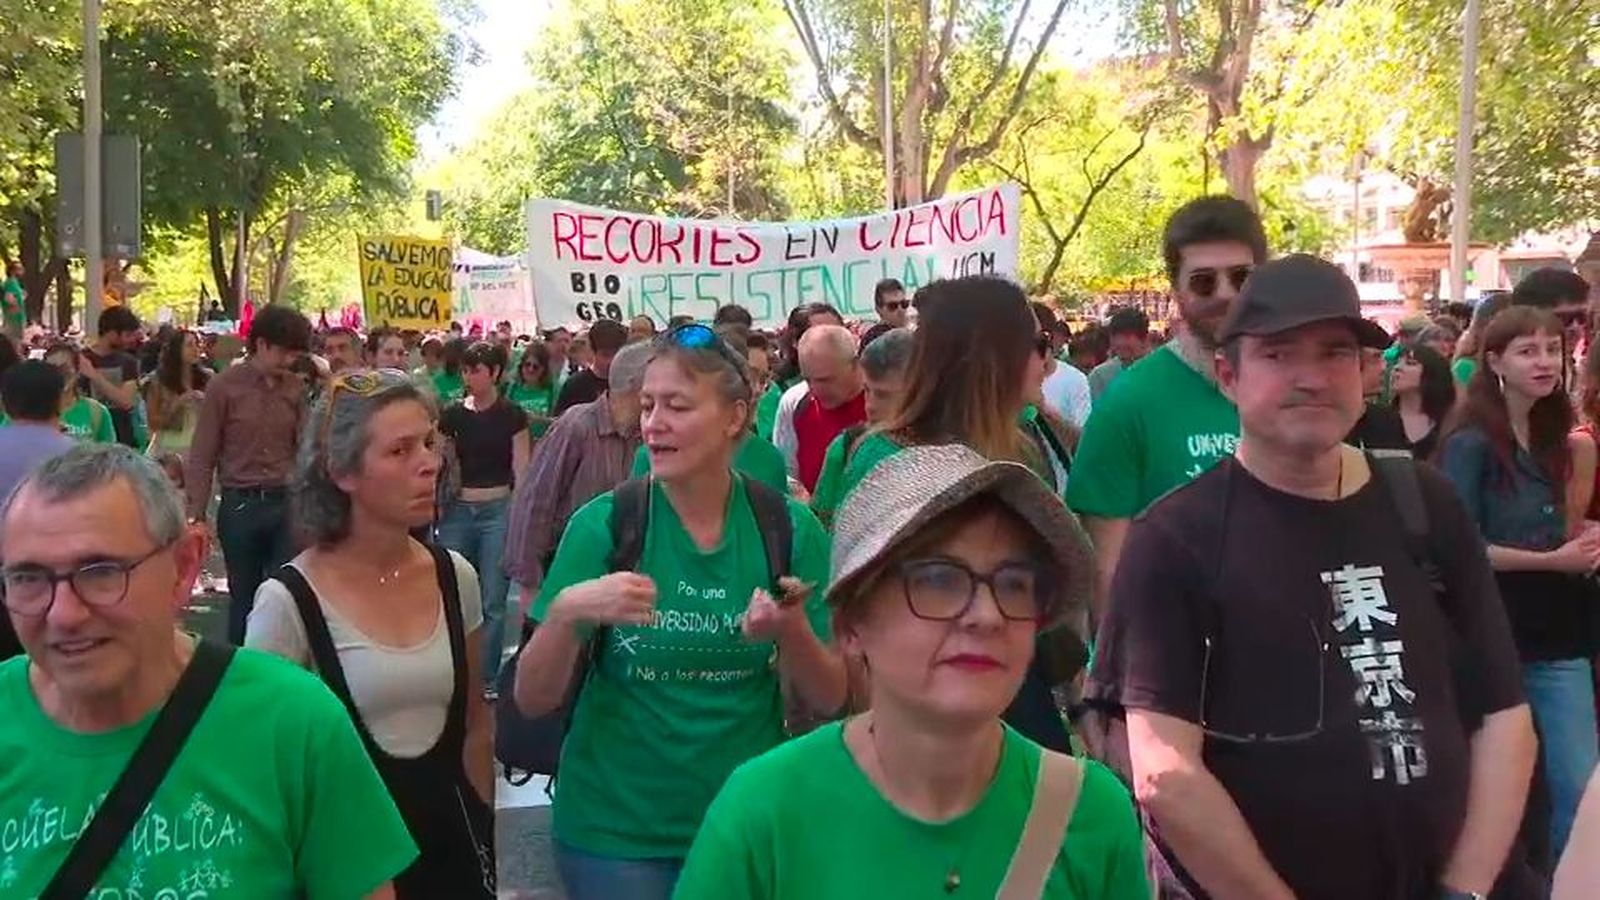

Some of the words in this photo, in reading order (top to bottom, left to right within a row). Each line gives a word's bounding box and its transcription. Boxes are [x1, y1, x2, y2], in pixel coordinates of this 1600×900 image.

[553, 212, 762, 267] RECORTES
[784, 226, 839, 261] EN
[858, 189, 1006, 252] CIENCIA
[367, 264, 387, 287] LA
[570, 271, 620, 295] BIO
[375, 289, 440, 322] PÚBLICA
[576, 301, 623, 323] GEO
[702, 587, 727, 600] una
